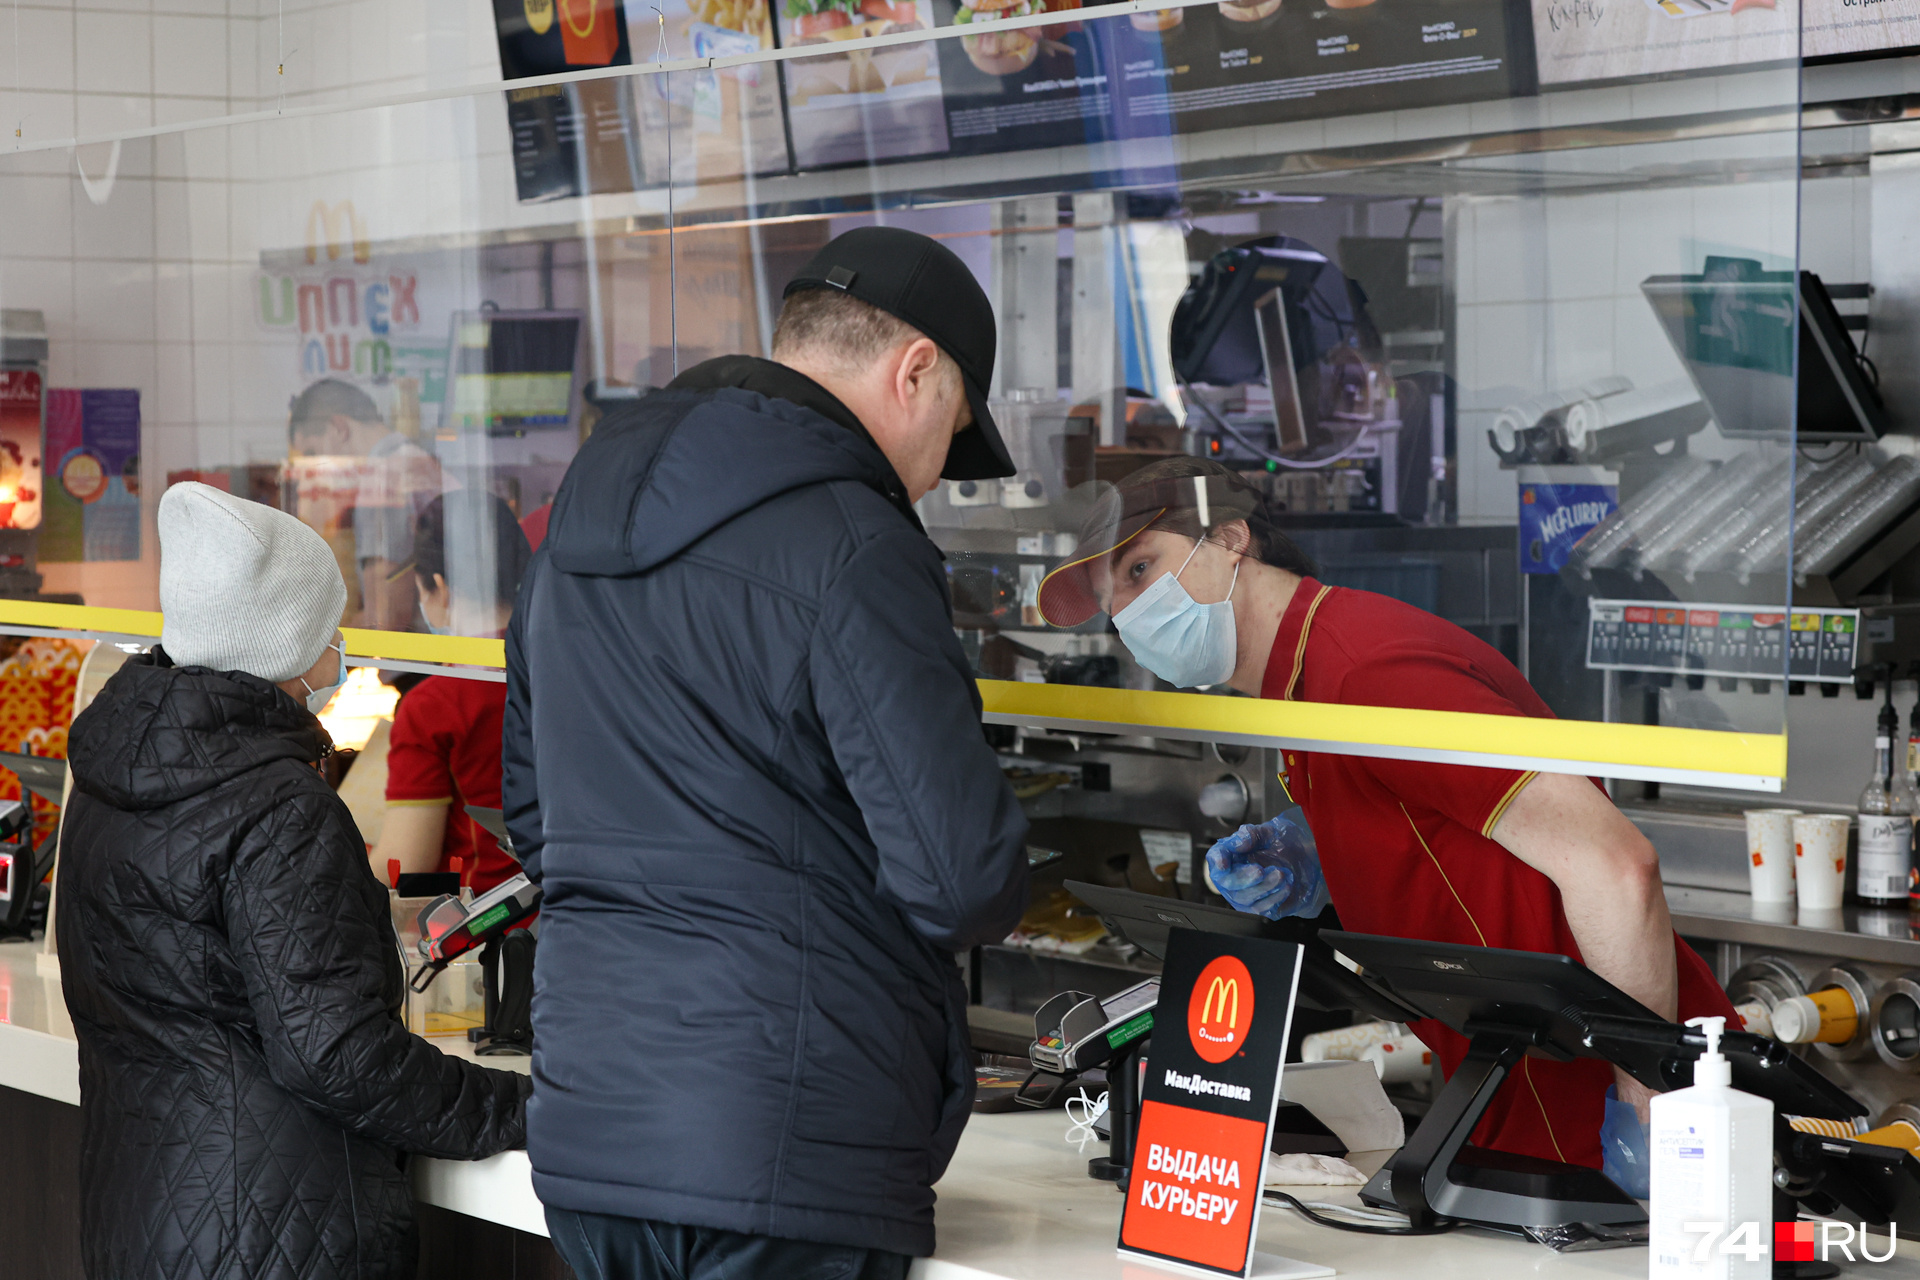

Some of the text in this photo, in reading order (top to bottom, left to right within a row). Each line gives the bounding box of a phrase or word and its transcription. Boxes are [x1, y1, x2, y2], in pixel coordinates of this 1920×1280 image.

[1164, 1069, 1251, 1102] МакДоставка
[1659, 1137, 1705, 1146] АНТИСЕПТИК
[1147, 1143, 1240, 1189] ВЫДАЧА
[1141, 1180, 1239, 1225] КУРЬЕРУ
